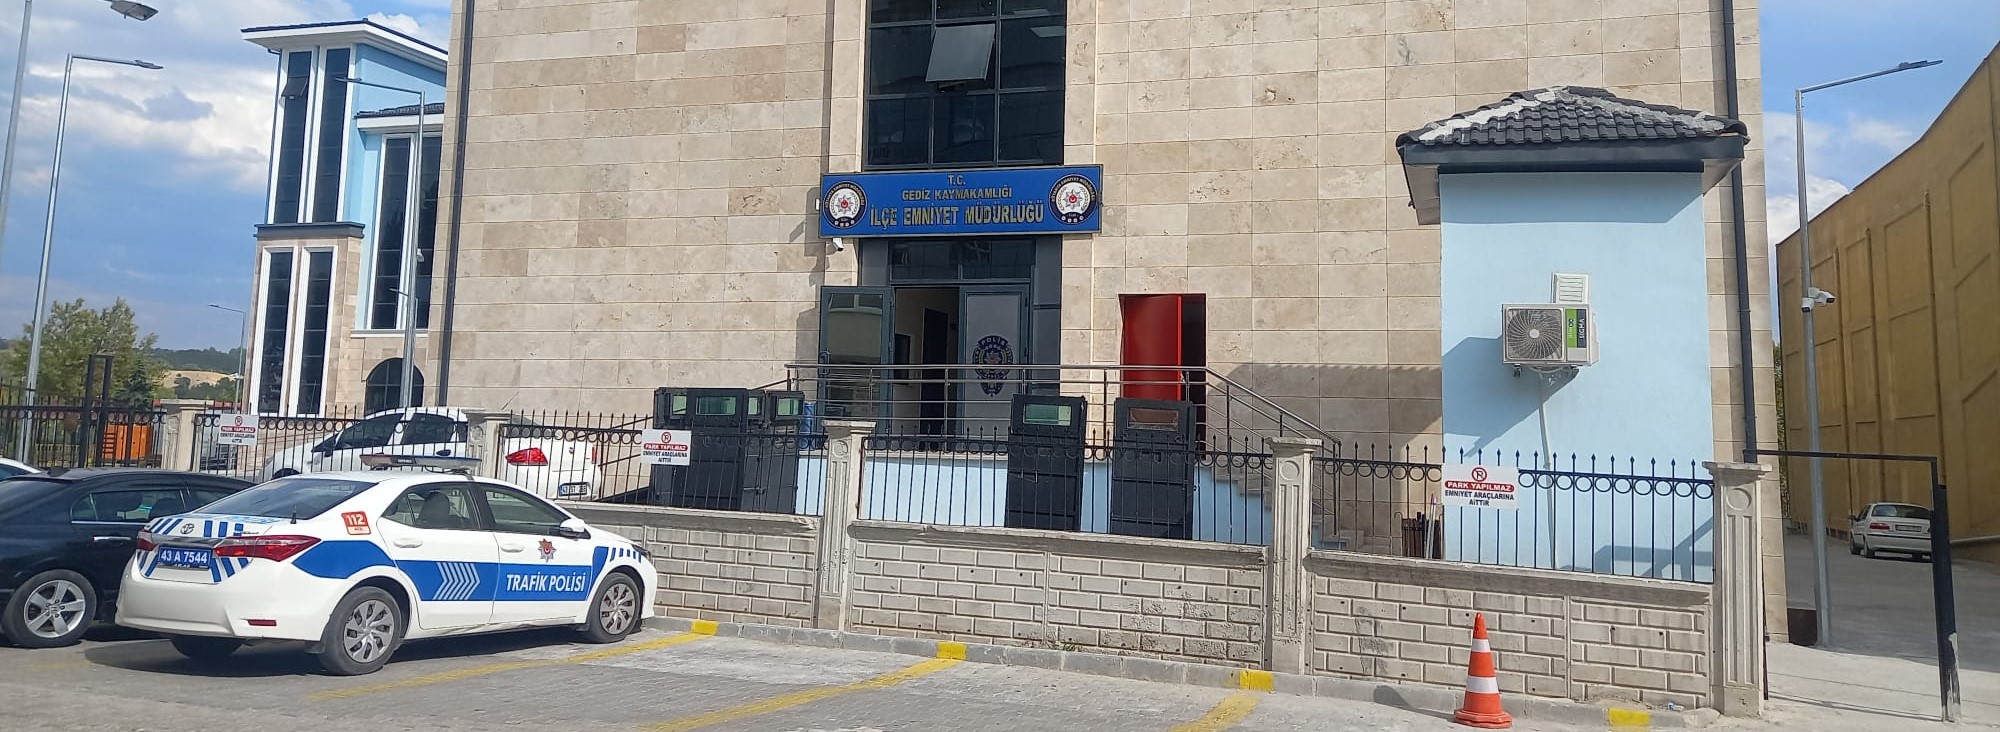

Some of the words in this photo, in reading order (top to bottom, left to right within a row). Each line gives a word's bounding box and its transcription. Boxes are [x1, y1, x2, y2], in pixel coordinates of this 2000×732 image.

[902, 188, 931, 200] GEDİZ
[934, 185, 1012, 200] KAYMAKAMLIĞI
[870, 204, 898, 229] İLÇE
[903, 203, 959, 226] EMNİYET
[964, 200, 1044, 224] MÜDÜRLÜĞÜ
[1447, 481, 1469, 489] PARK
[1471, 482, 1512, 491] YAPILMAZ
[1445, 490, 1472, 498] EMNİYET
[1473, 492, 1515, 500] ARAÇLARINA
[345, 513, 366, 526] 112
[161, 550, 172, 561] 43
[174, 551, 181, 562] A
[184, 551, 208, 564] 7544
[506, 571, 548, 592] TRAFİK
[548, 571, 586, 592] POLİSİ
